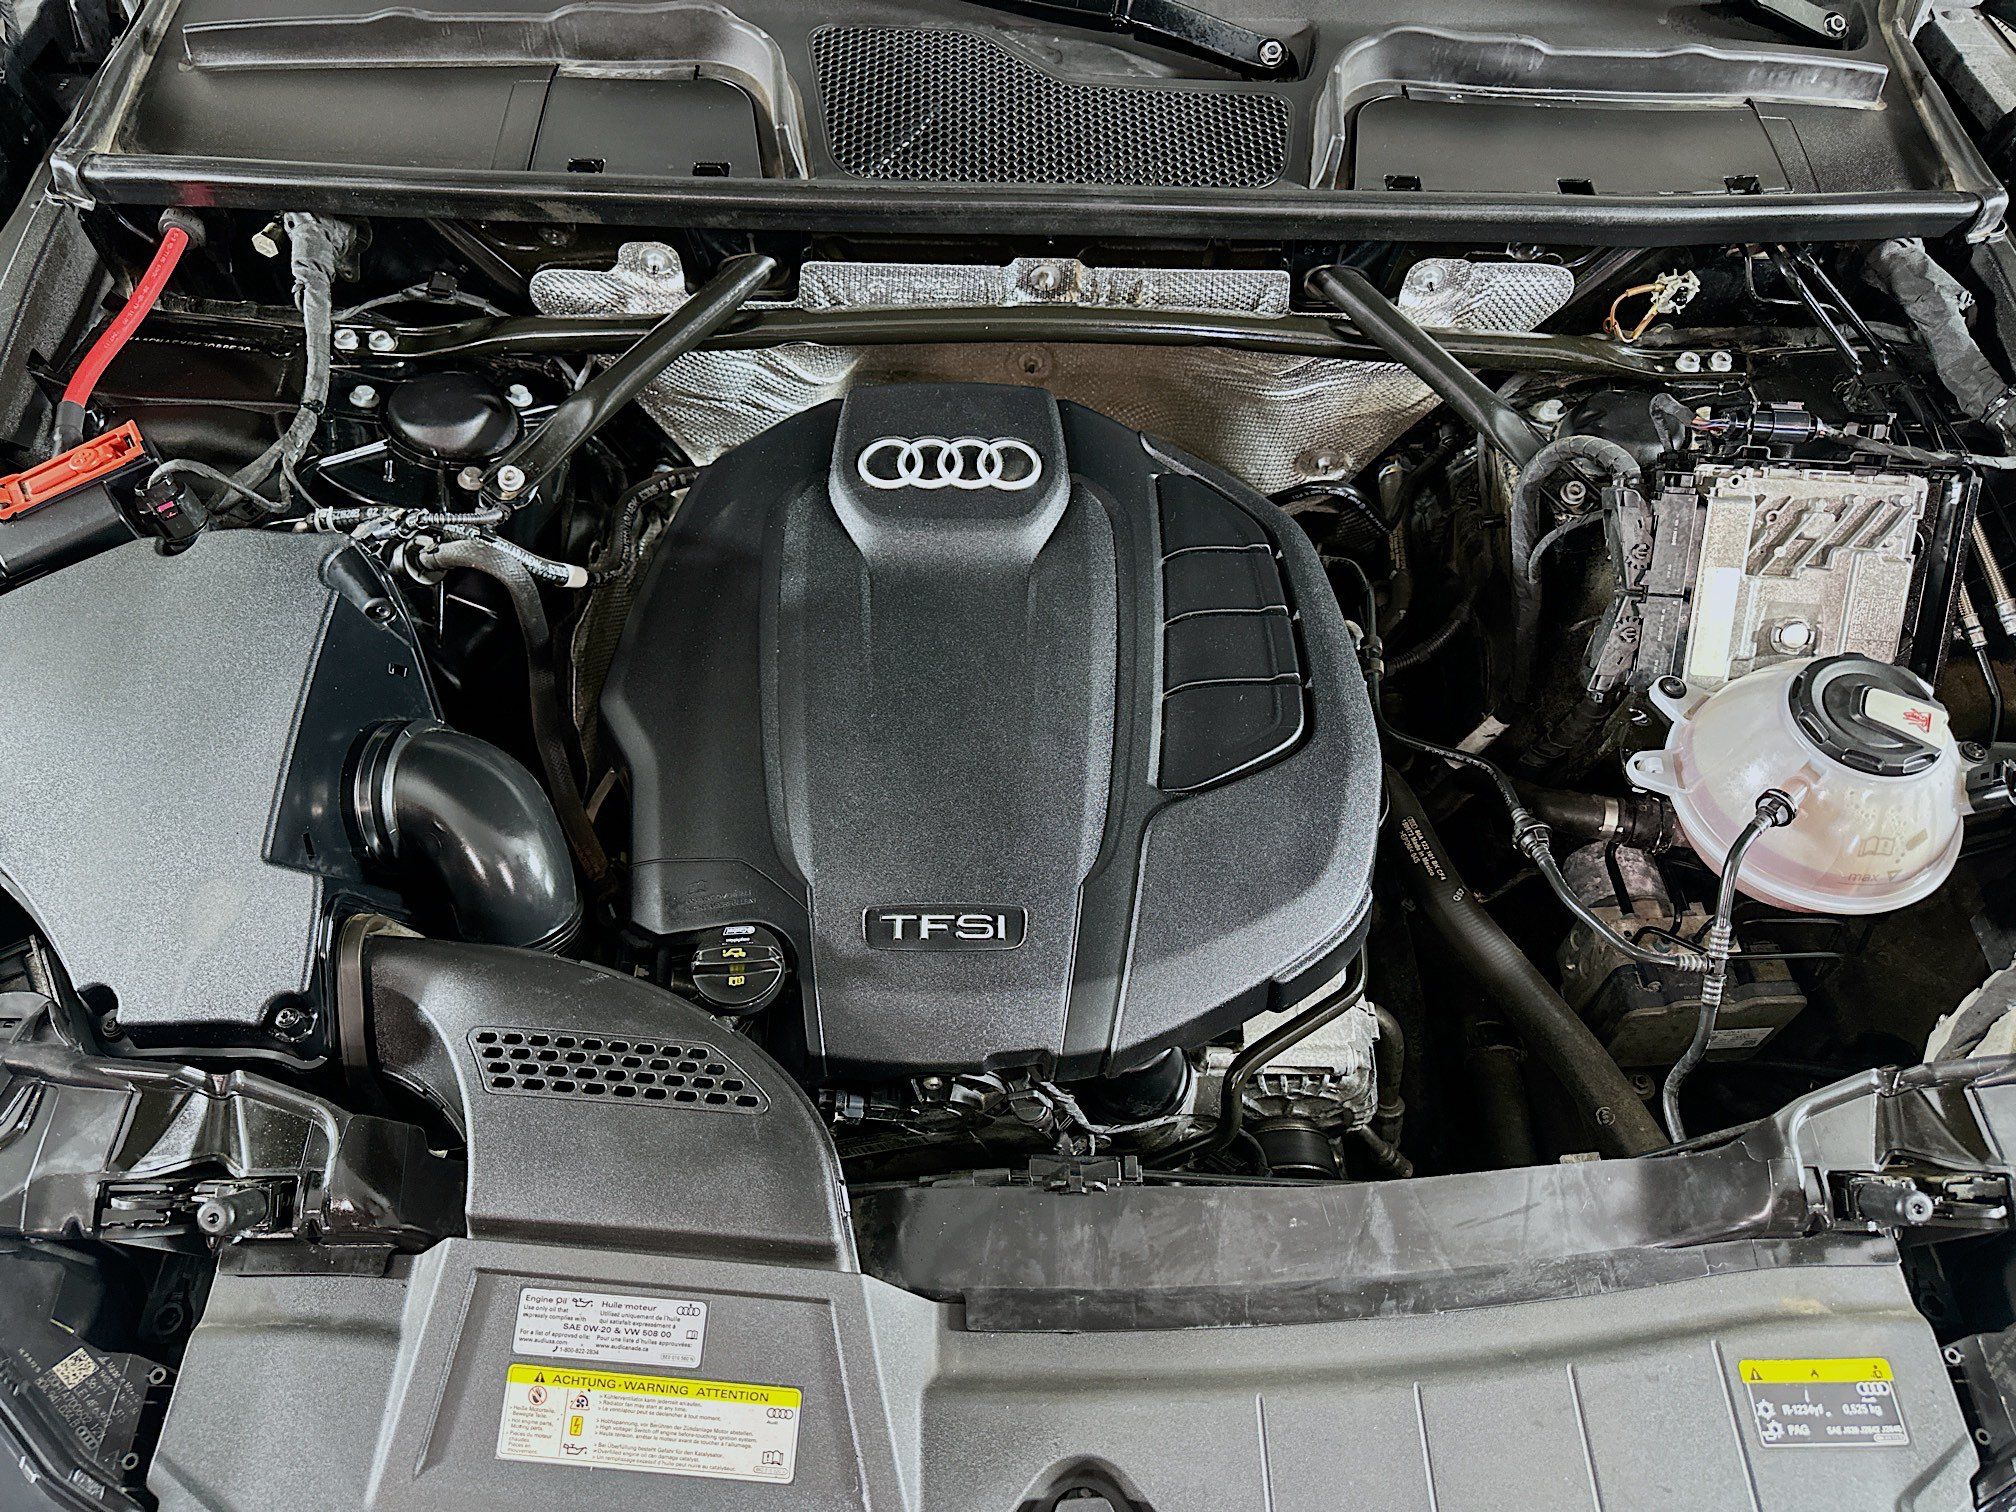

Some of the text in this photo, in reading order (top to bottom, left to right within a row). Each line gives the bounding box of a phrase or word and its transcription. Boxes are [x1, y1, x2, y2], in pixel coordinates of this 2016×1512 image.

[1422, 856, 1435, 877] Mexico
[1848, 872, 1879, 882] max
[880, 914, 1005, 940] TFSI
[524, 1294, 567, 1304] Engine Oil
[601, 1300, 657, 1311] Huile moteur
[562, 1322, 581, 1330] SAE
[583, 1324, 612, 1333] 0W-20
[623, 1327, 640, 1335] VW
[642, 1329, 658, 1337] 508
[660, 1330, 671, 1338] 00
[552, 1374, 769, 1402] ACHTUNG WARNING ATTENTION
